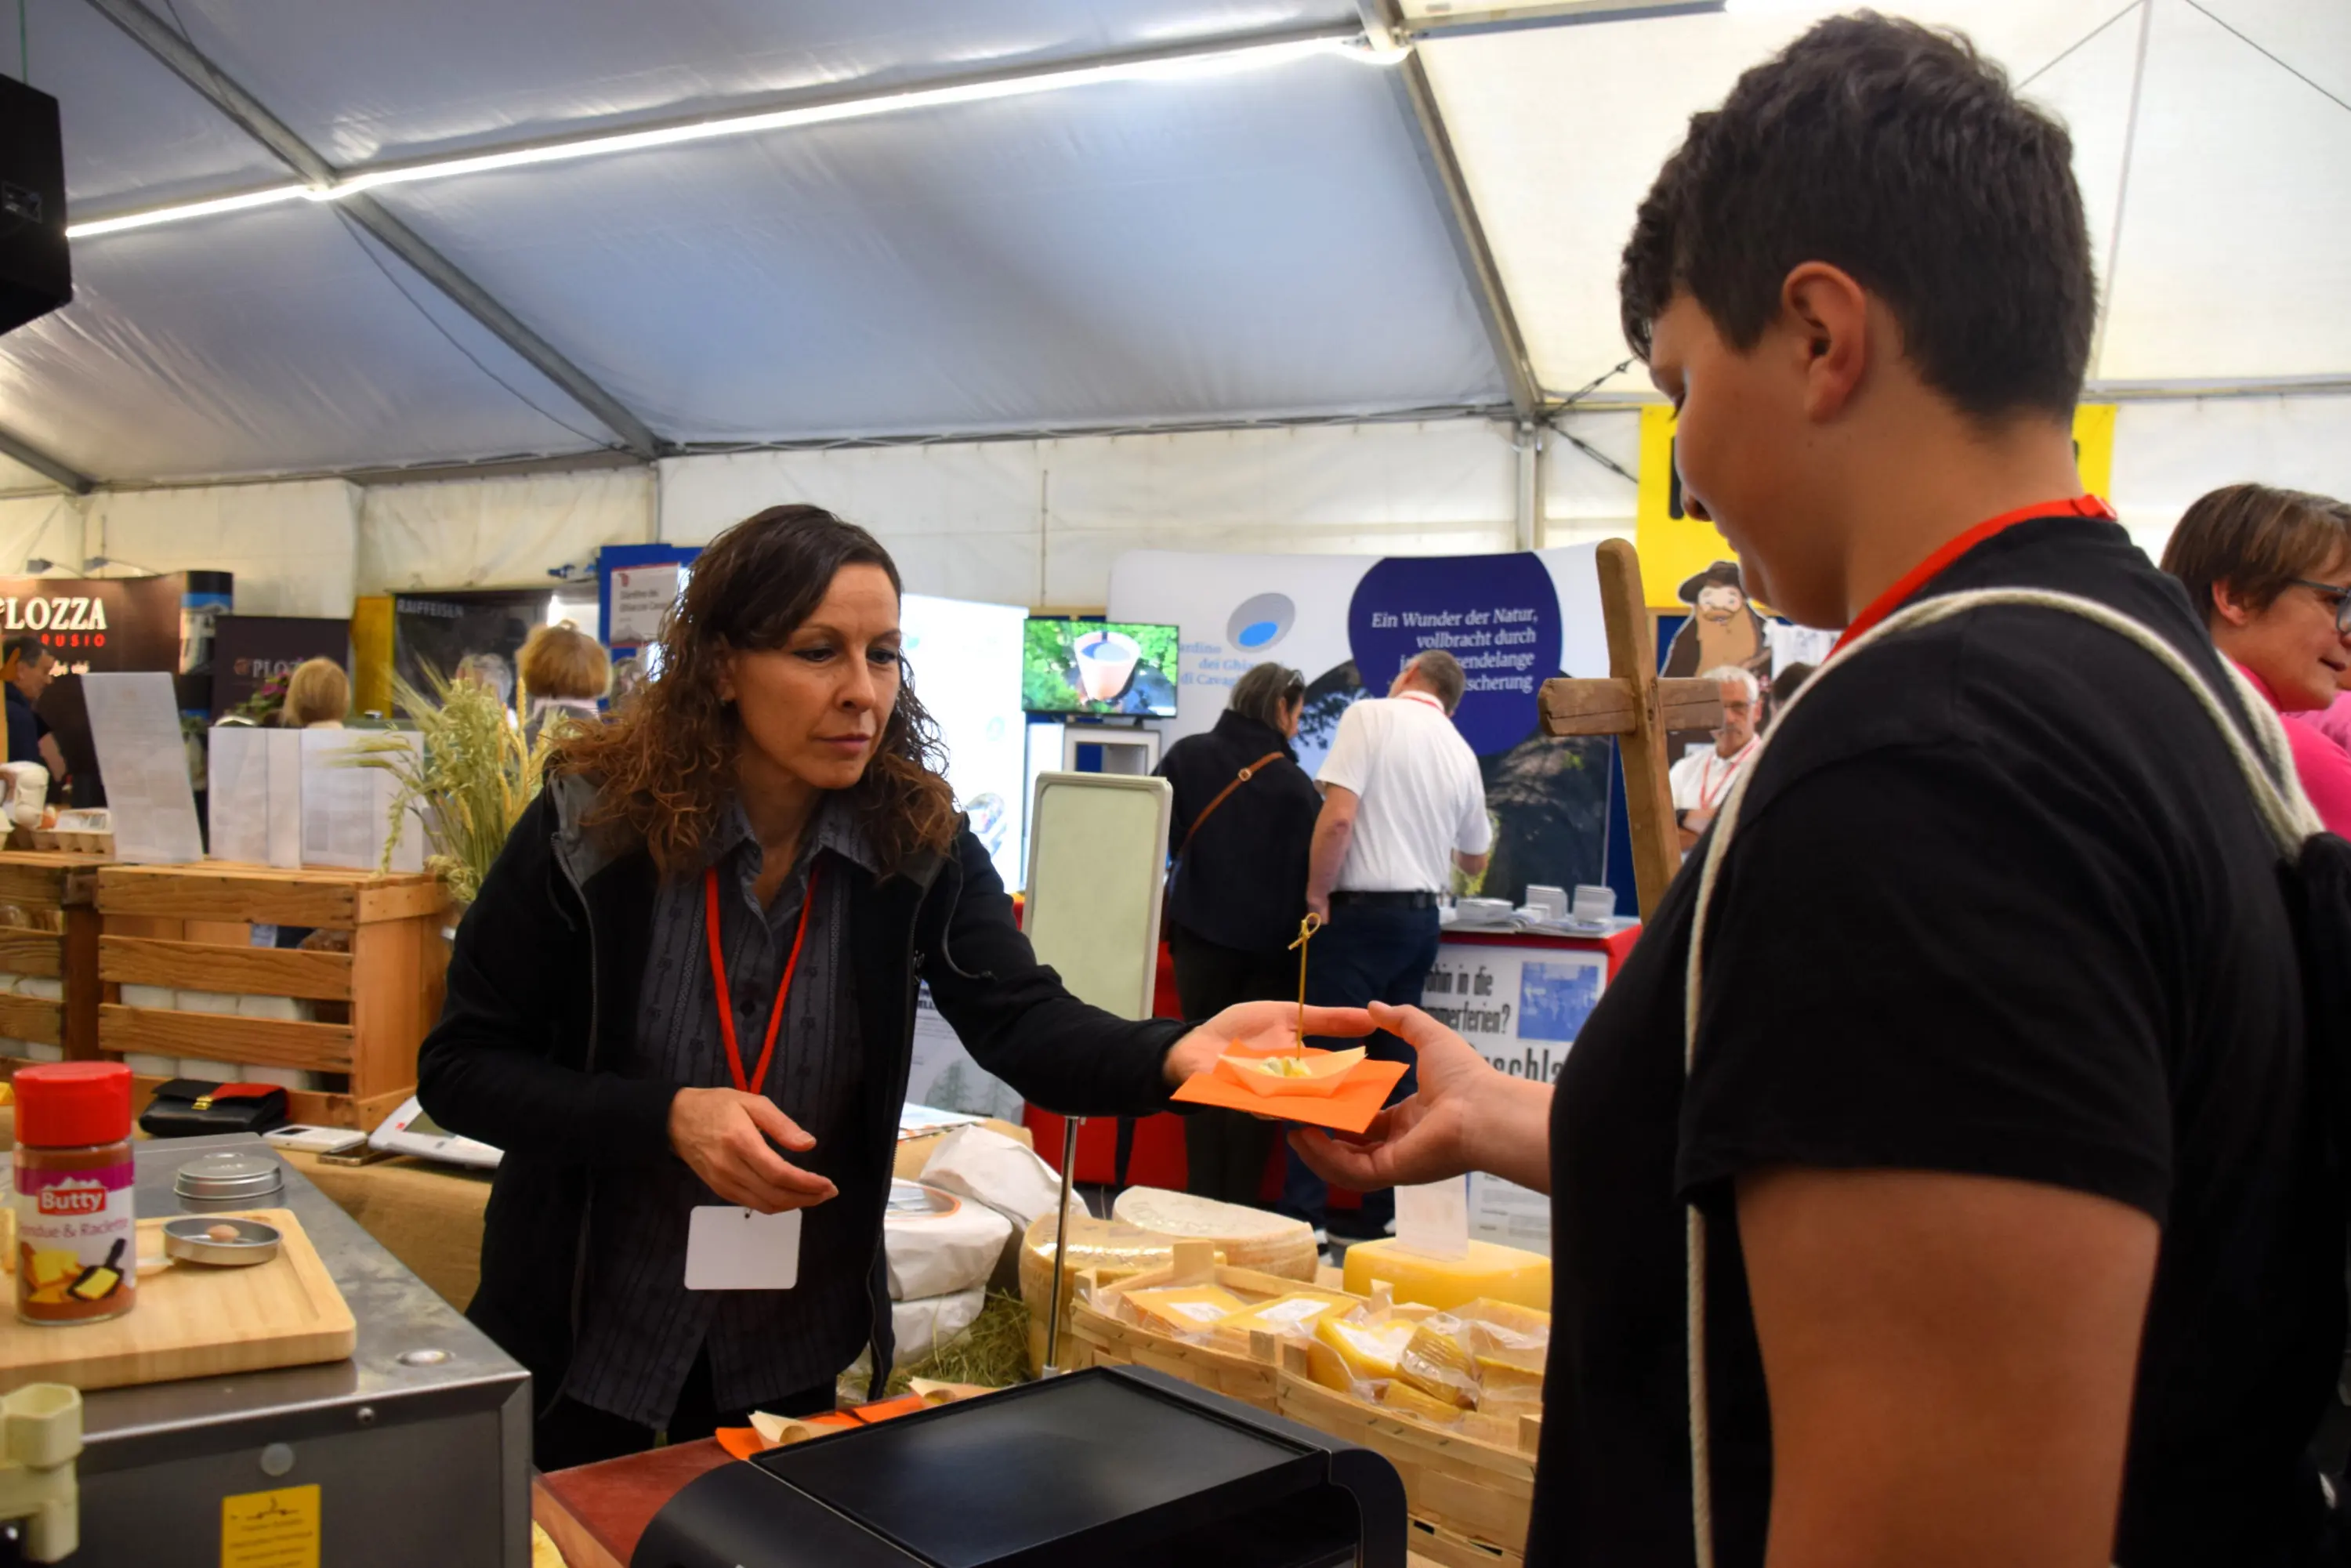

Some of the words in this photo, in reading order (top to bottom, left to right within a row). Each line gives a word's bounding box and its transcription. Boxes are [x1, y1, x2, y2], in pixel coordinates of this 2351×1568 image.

[1372, 613, 1397, 628] Ein
[1403, 610, 1462, 627] Wunder
[1465, 609, 1489, 625] der
[1493, 607, 1538, 624] Natur,
[1416, 629, 1491, 649] vollbracht
[1494, 626, 1536, 645] durch
[1457, 964, 1469, 995] in
[42, 1192, 103, 1211] Butty
[63, 1224, 77, 1238] &
